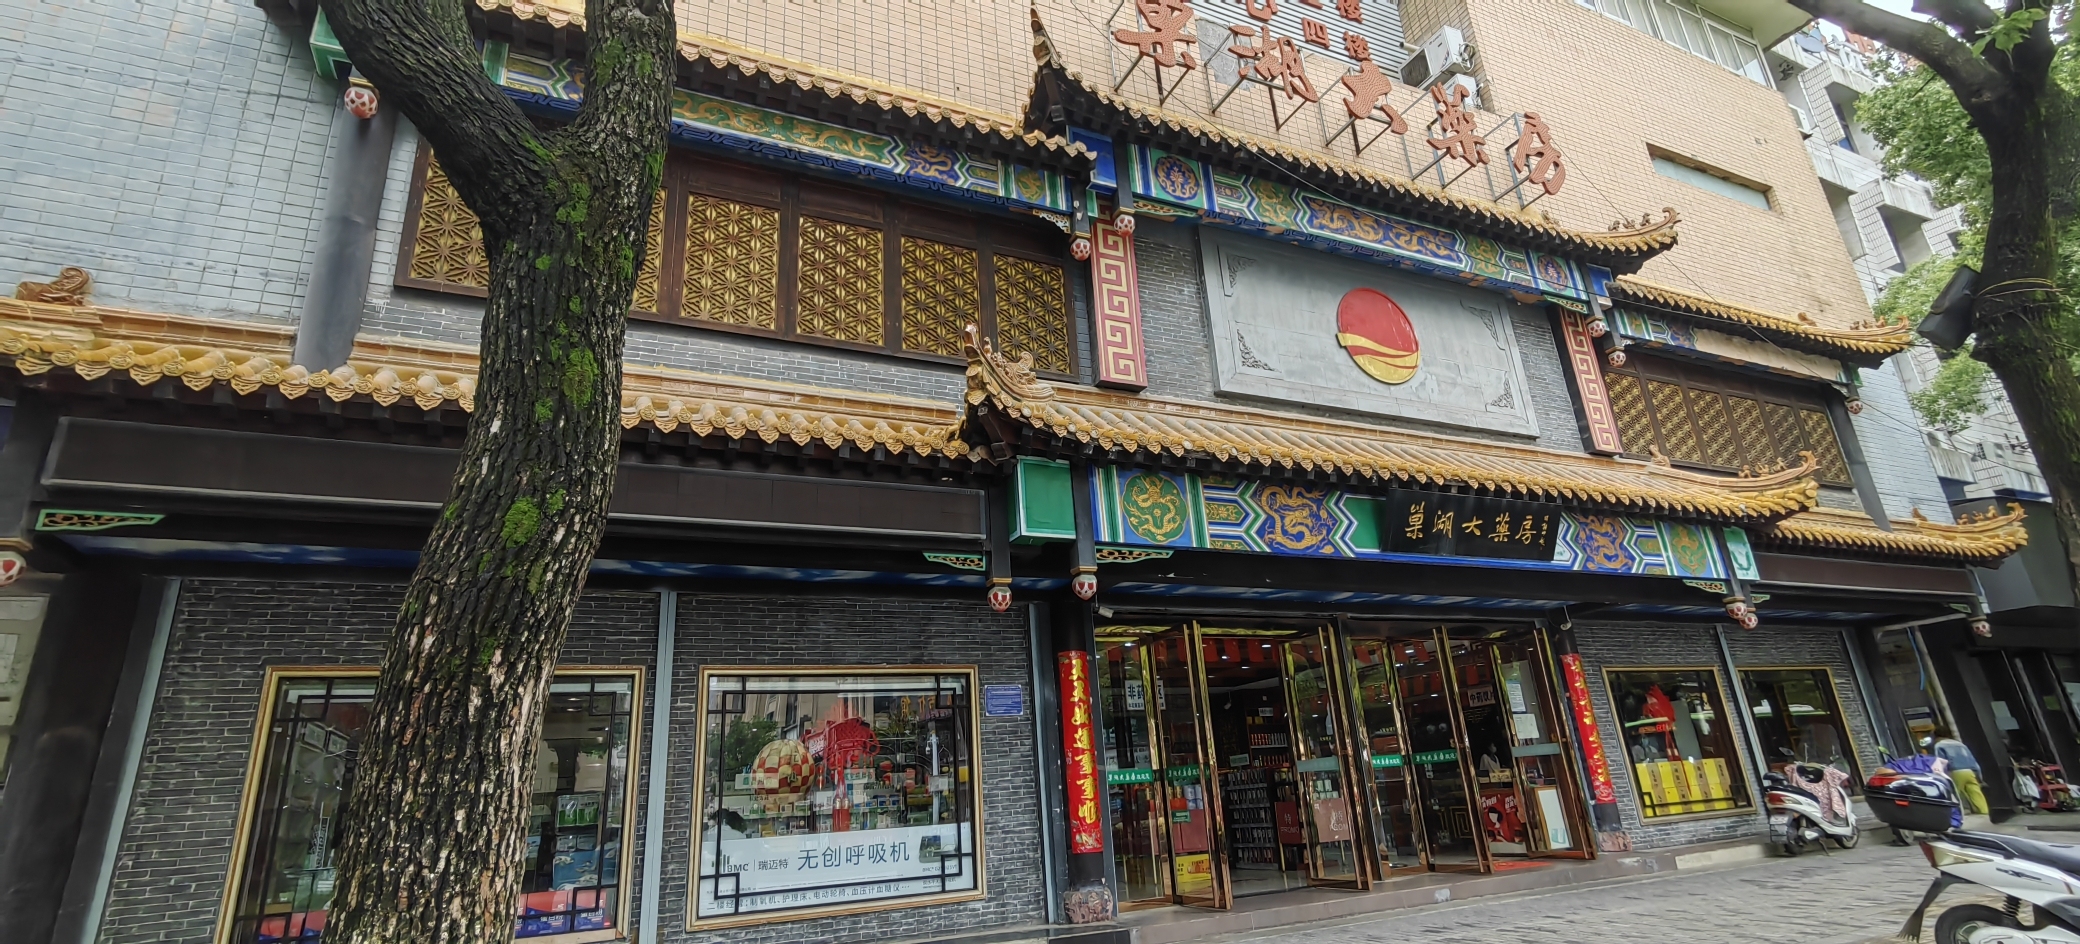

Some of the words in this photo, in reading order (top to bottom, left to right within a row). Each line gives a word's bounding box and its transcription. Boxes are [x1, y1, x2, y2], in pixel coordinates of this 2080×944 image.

[1301, 17, 1373, 62] 四楼
[758, 859, 788, 871] 瑞迈特
[798, 841, 910, 871] 无创呼吸机
